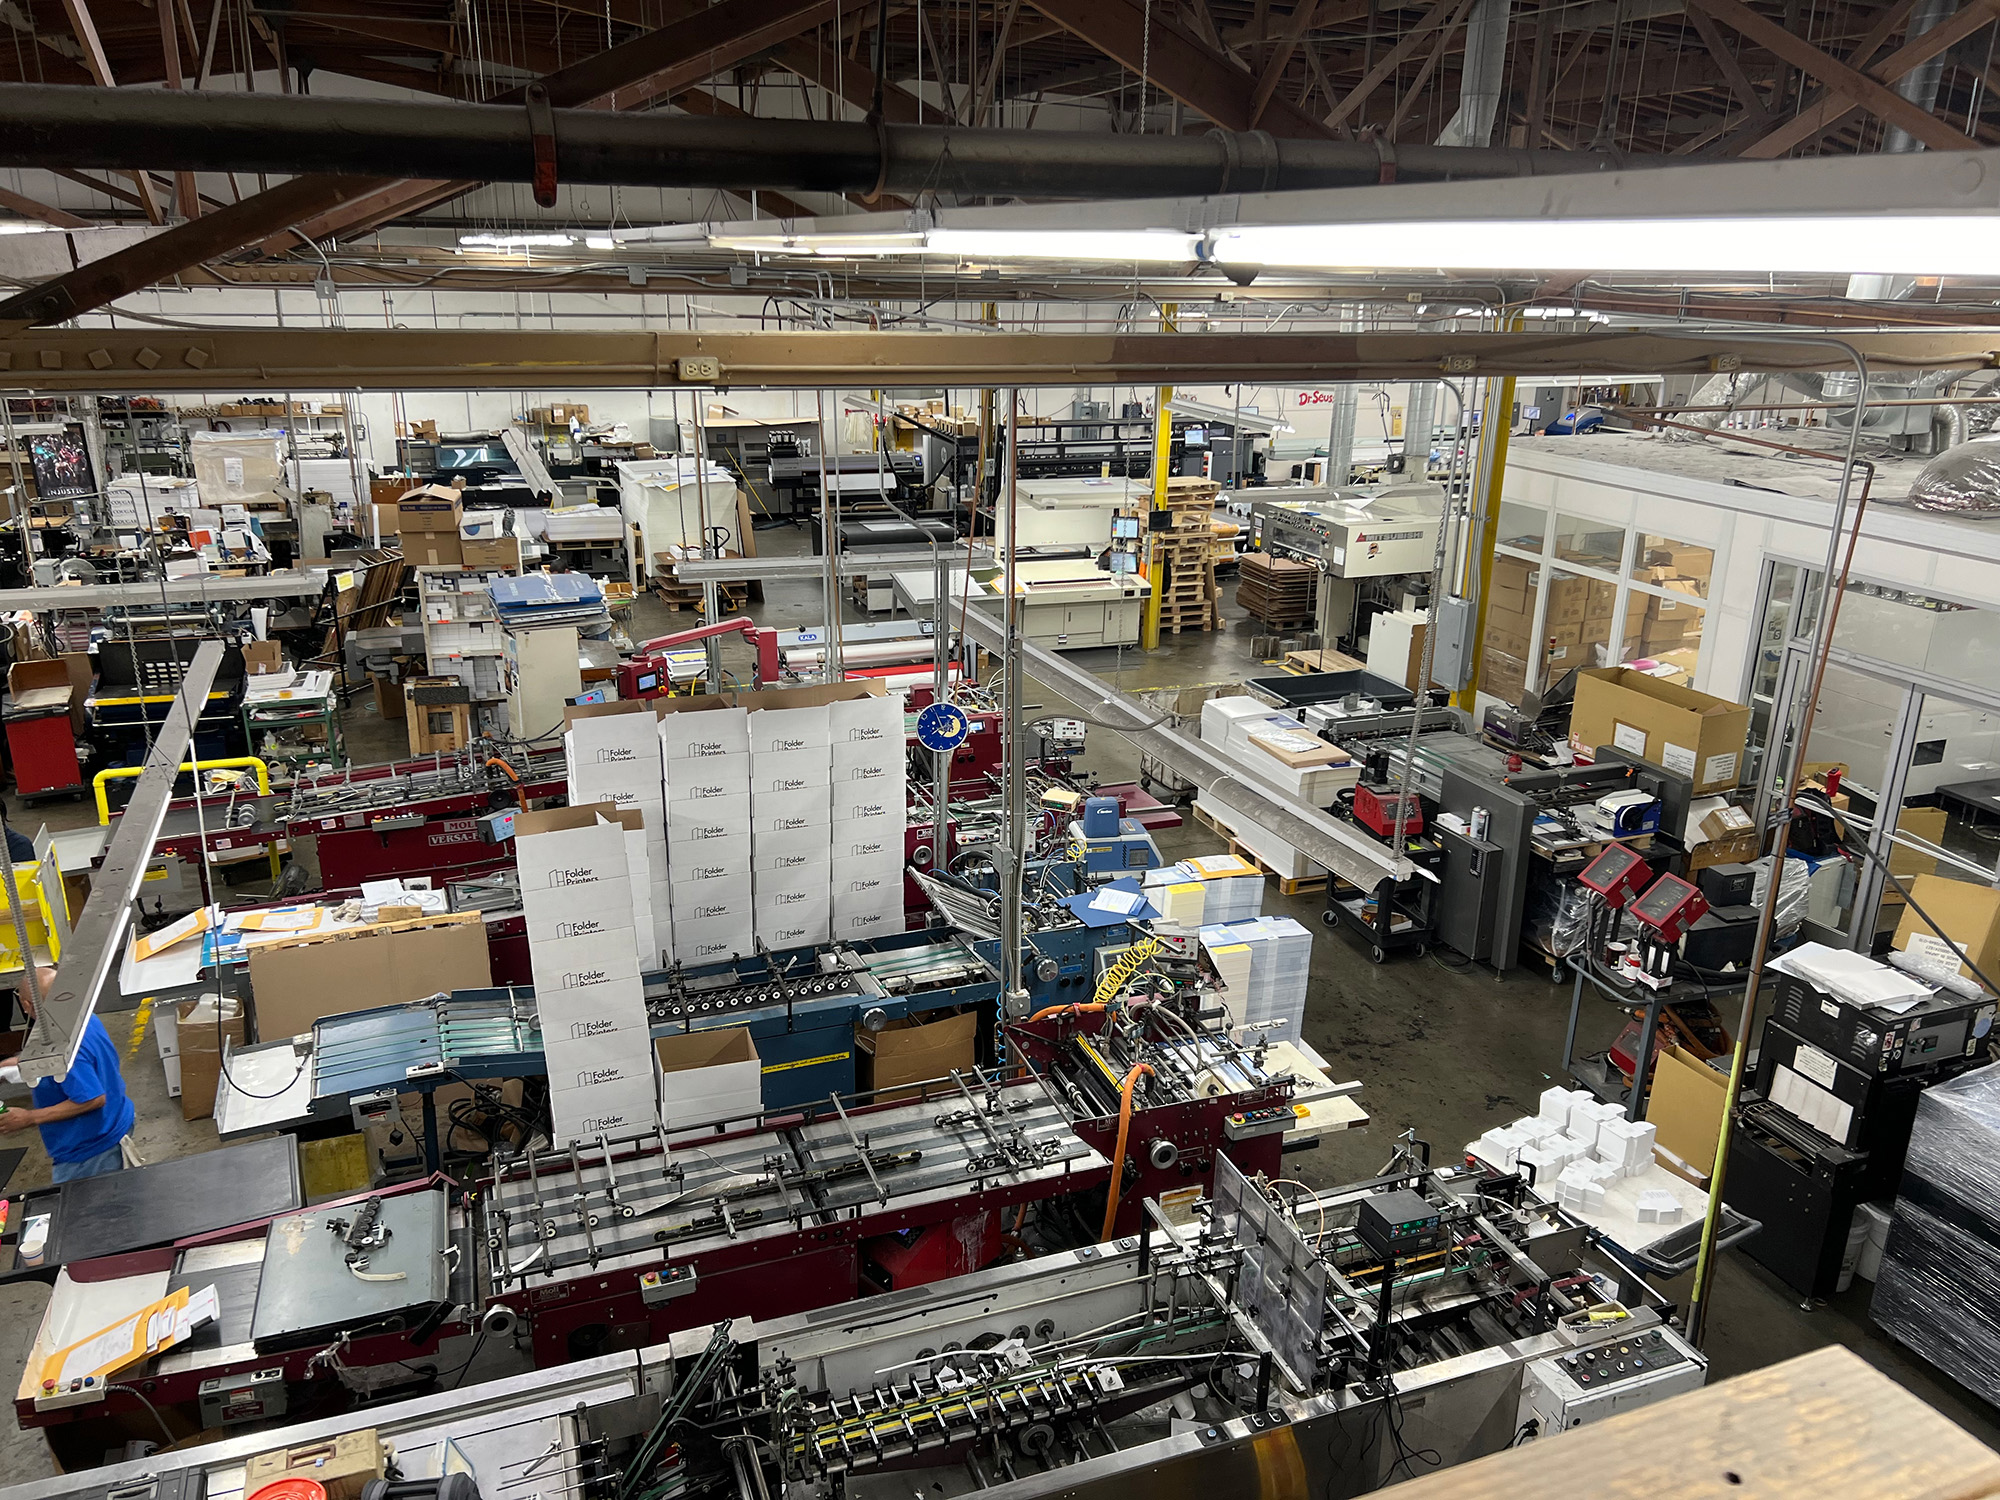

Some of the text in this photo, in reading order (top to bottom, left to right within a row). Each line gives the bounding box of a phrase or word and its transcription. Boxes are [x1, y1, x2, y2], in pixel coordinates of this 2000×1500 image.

[1312, 390, 1334, 404] Seus
[1366, 531, 1423, 541] MITSUBISHI
[610, 748, 632, 756] Folder
[613, 792, 634, 800] Folder
[565, 867, 592, 878] Folder
[572, 920, 600, 931] Folder
[578, 971, 605, 981] Folder
[586, 1020, 612, 1030] Folder
[593, 1068, 619, 1079] Folder
[598, 1116, 623, 1126] Folder
[540, 1286, 559, 1296] Moll
